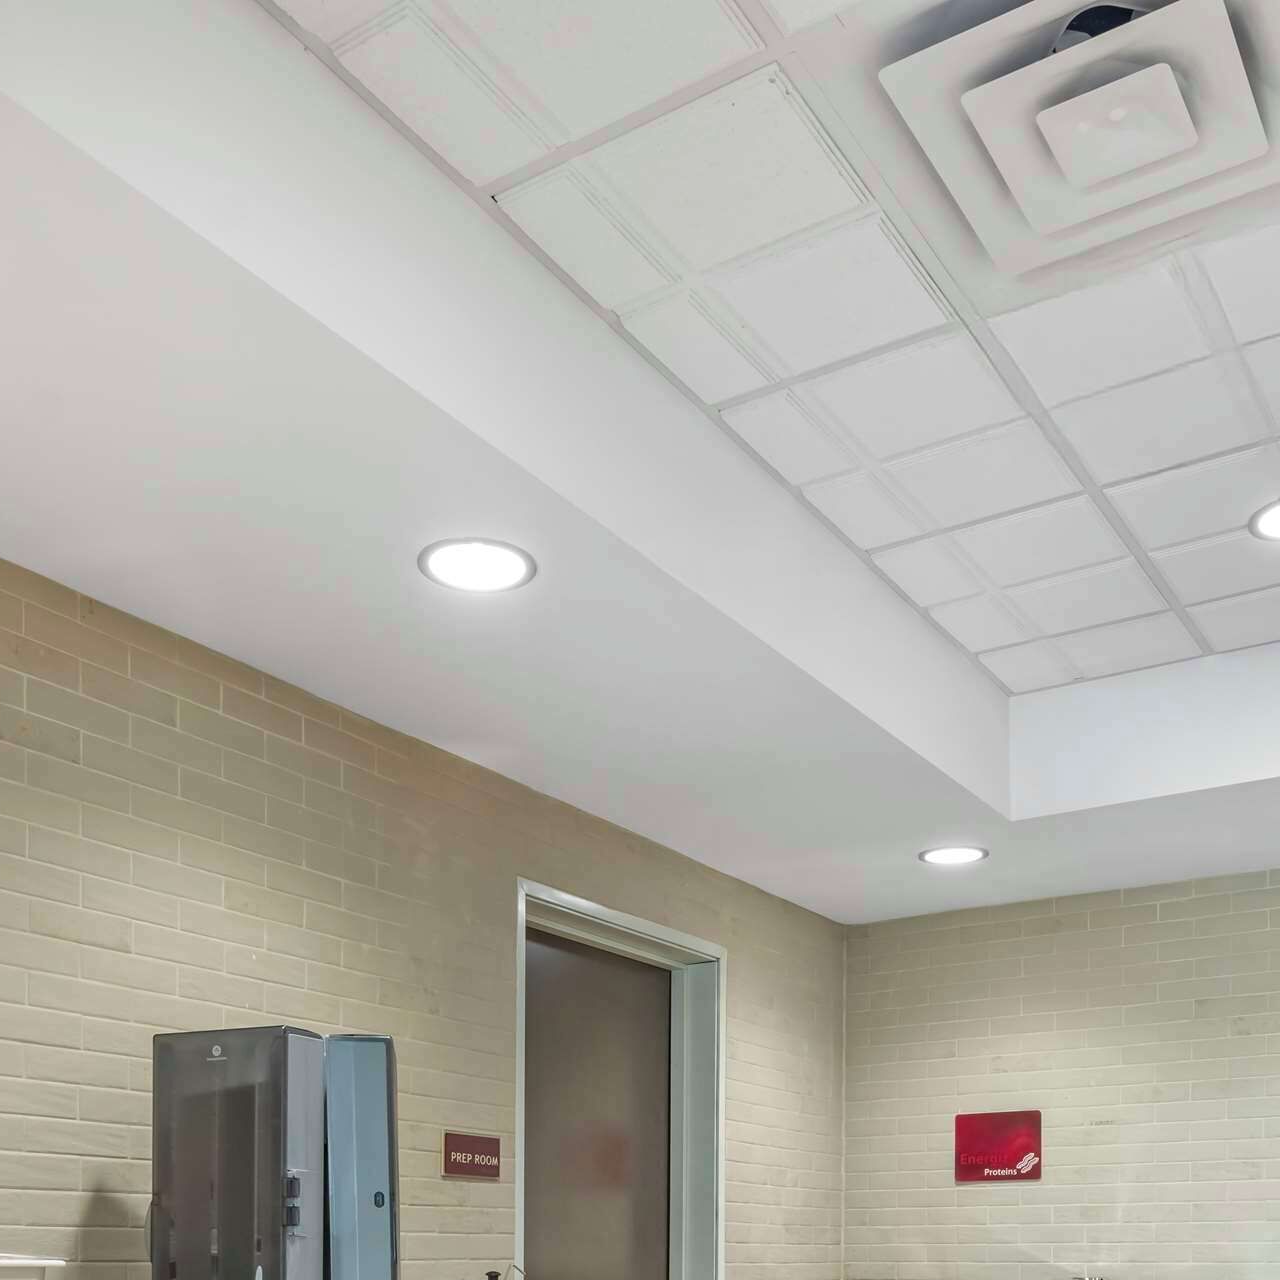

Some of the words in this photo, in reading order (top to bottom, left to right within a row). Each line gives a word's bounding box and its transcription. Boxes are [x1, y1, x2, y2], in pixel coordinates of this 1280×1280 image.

[450, 1151, 473, 1164] PREP
[474, 1154, 499, 1167] ROOM
[984, 1168, 1018, 1176] Proteins
